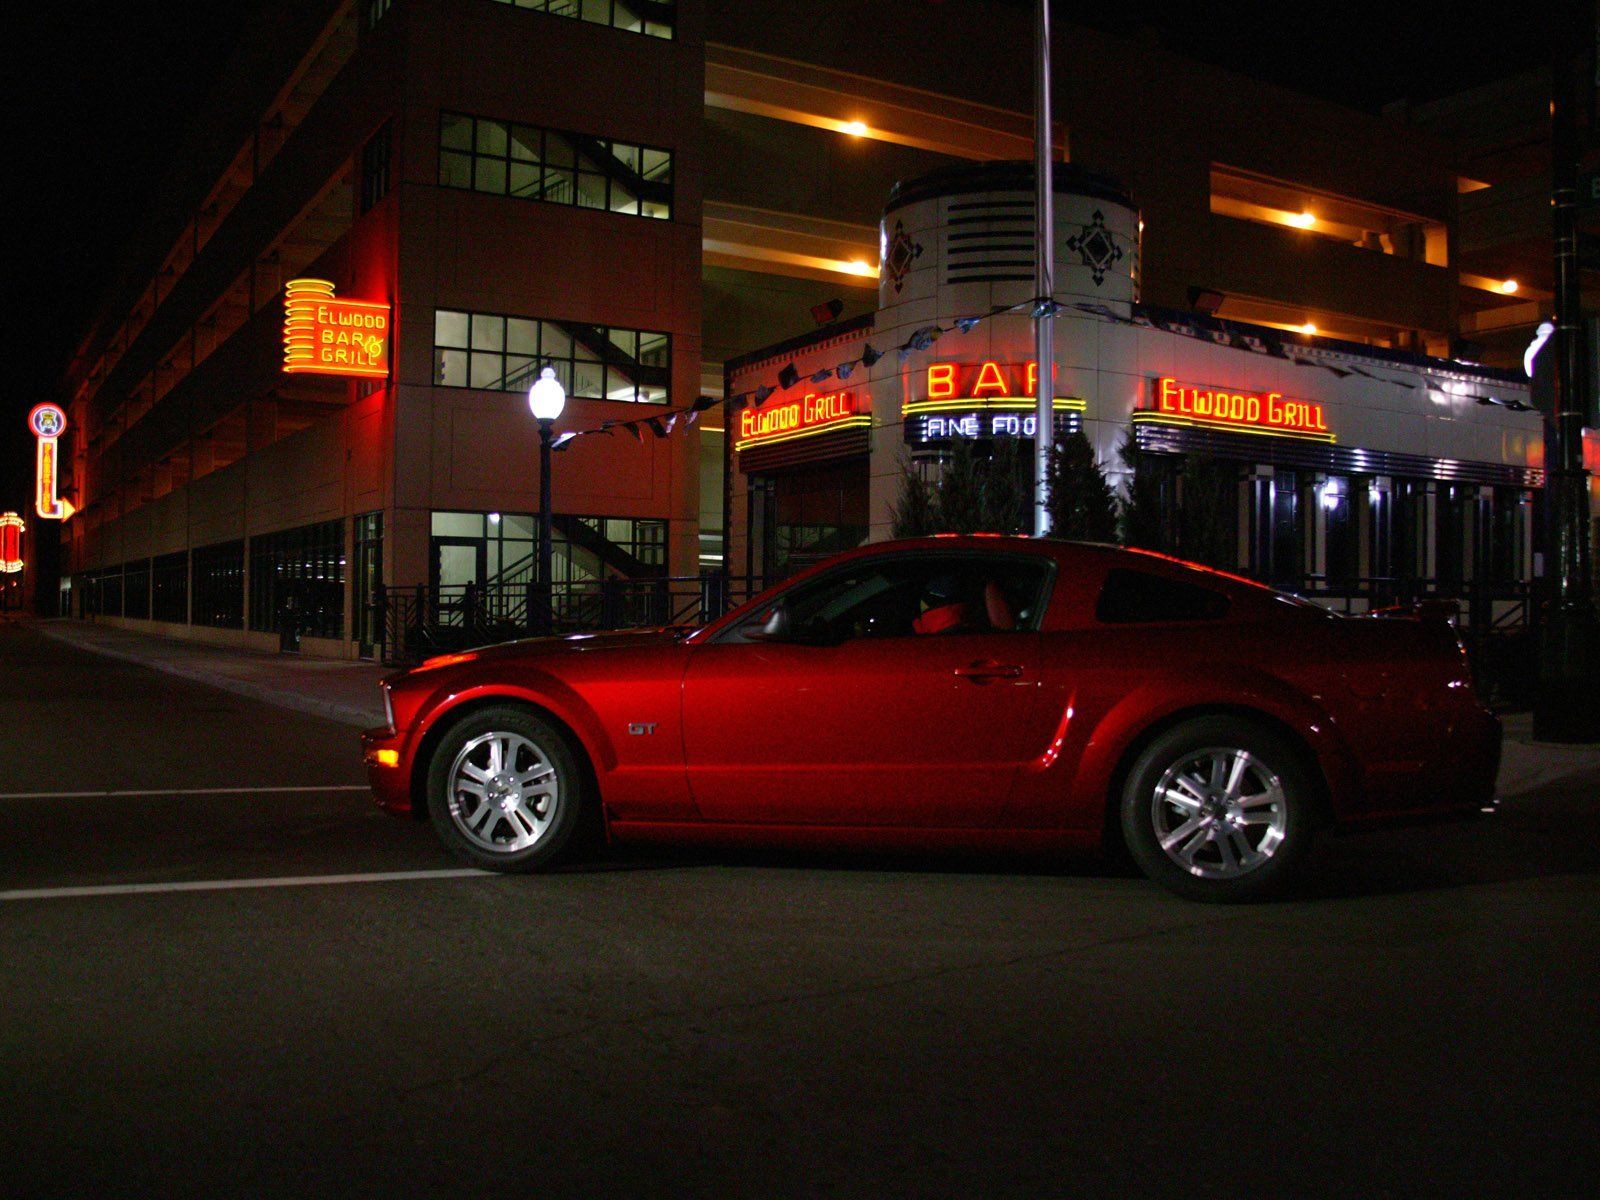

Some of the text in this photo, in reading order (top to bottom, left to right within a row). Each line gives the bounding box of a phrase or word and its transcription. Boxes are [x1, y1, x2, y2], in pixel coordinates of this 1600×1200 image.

[318, 306, 386, 329] ELWOOD
[321, 329, 384, 358] BAR &
[321, 348, 377, 366] GRILL
[741, 393, 850, 438] ELWOOD GRILL
[1162, 378, 1327, 430] ELWOOD GRILL
[927, 416, 1037, 437] FINE FOO
[628, 722, 657, 735] GT
